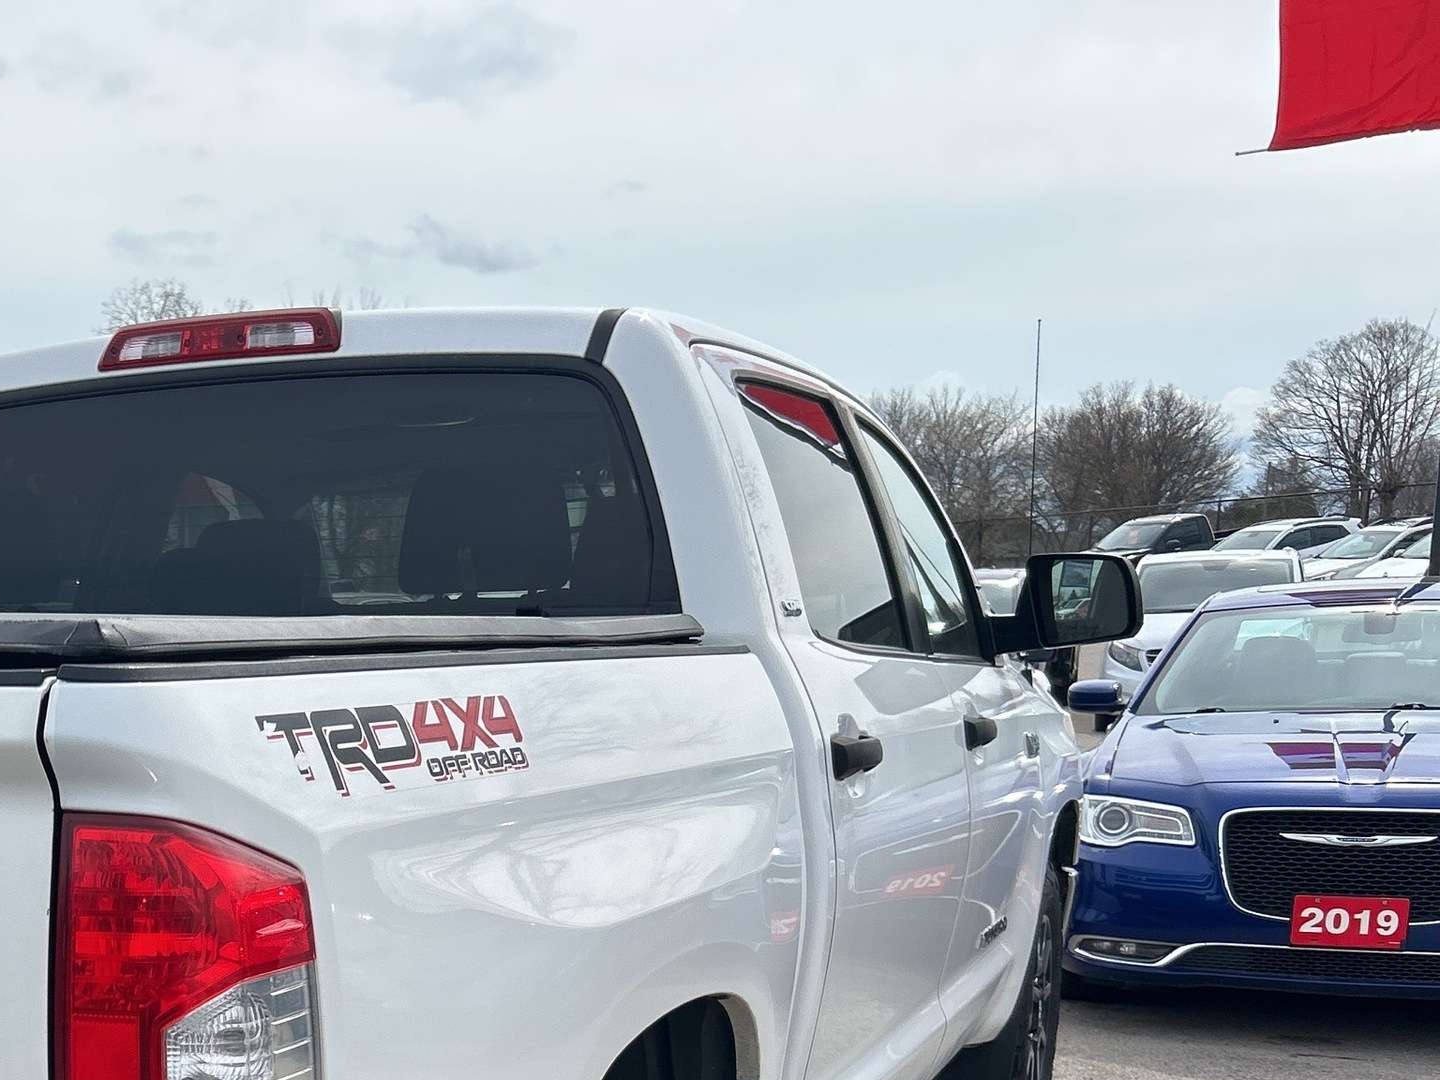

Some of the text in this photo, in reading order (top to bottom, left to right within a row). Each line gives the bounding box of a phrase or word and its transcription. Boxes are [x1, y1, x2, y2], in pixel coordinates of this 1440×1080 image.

[426, 747, 529, 782] OFF ROAD
[1298, 907, 1400, 936] 2019
